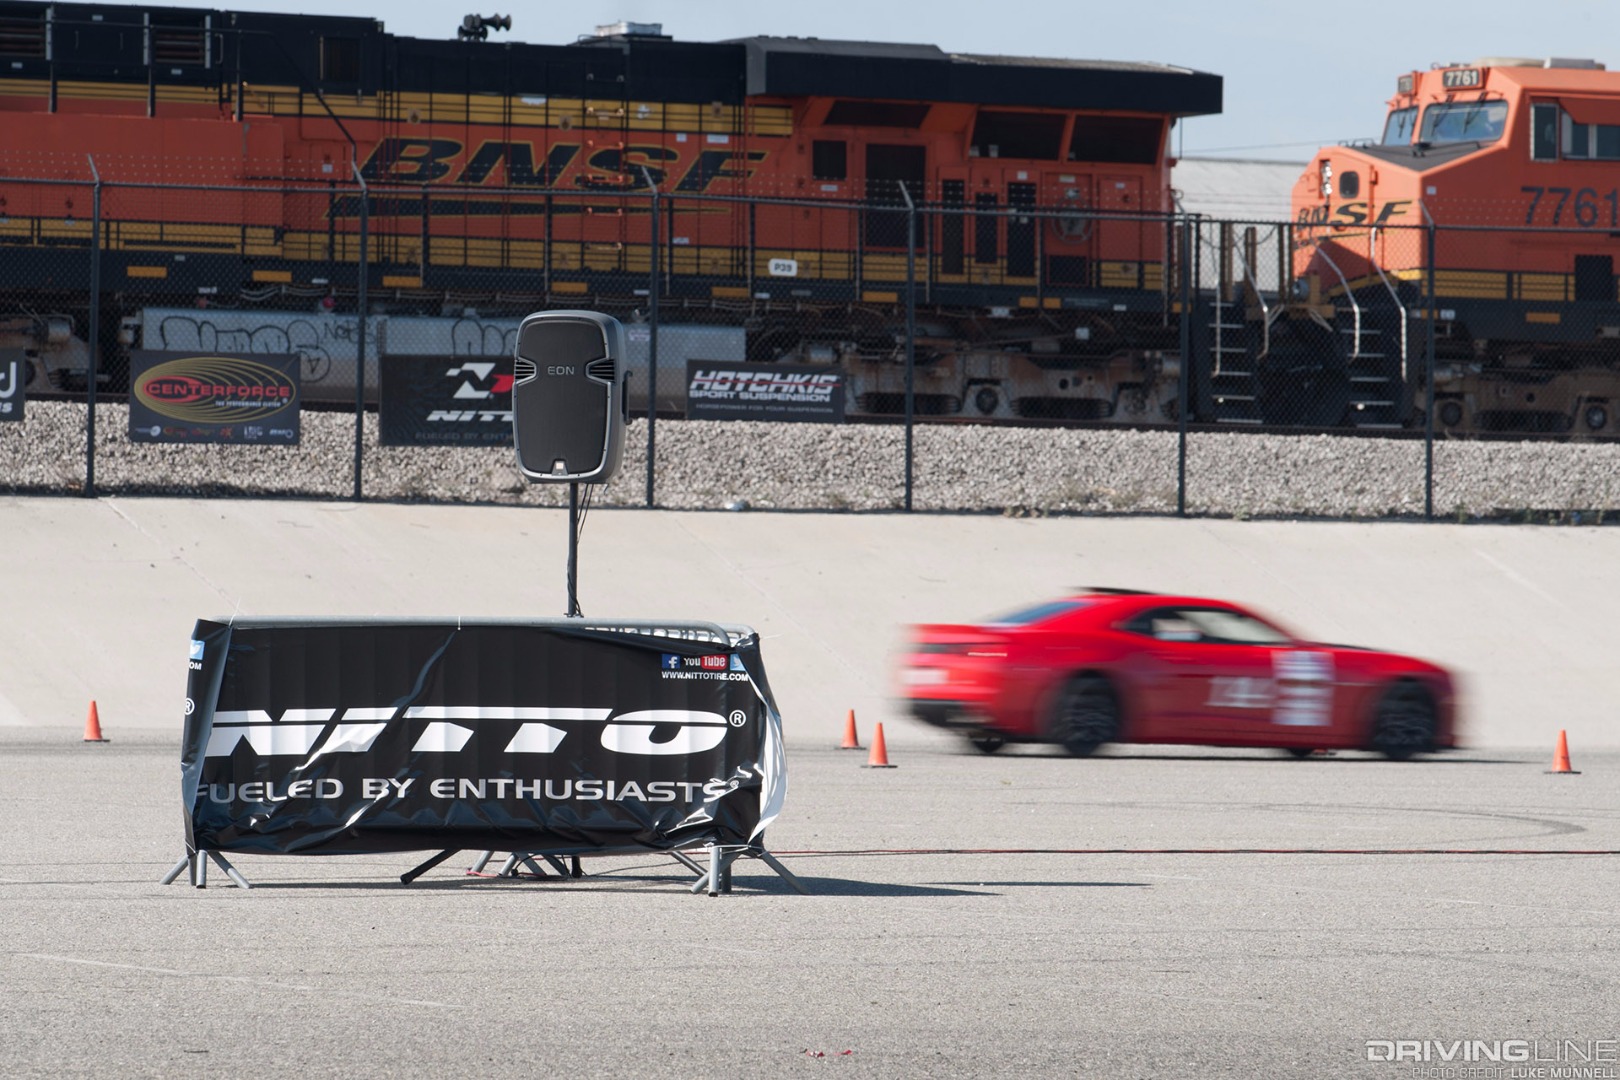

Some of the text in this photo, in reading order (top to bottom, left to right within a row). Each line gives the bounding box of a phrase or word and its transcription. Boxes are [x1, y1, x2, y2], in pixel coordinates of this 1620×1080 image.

[1446, 71, 1478, 87] 7761
[357, 137, 769, 194] BNSF
[1520, 187, 1618, 228] 7761
[547, 365, 575, 376] EON
[689, 370, 838, 395] HOTCHKIS
[148, 384, 291, 398] CENTERFORCE
[689, 390, 831, 403] SPORT SUSPENSION
[426, 410, 513, 421] NITT
[661, 671, 748, 681] WWW.NITTOTIRE.COM
[204, 705, 728, 757] NITTO
[362, 778, 416, 799] BY
[429, 778, 727, 803] ENTHUSIASTS
